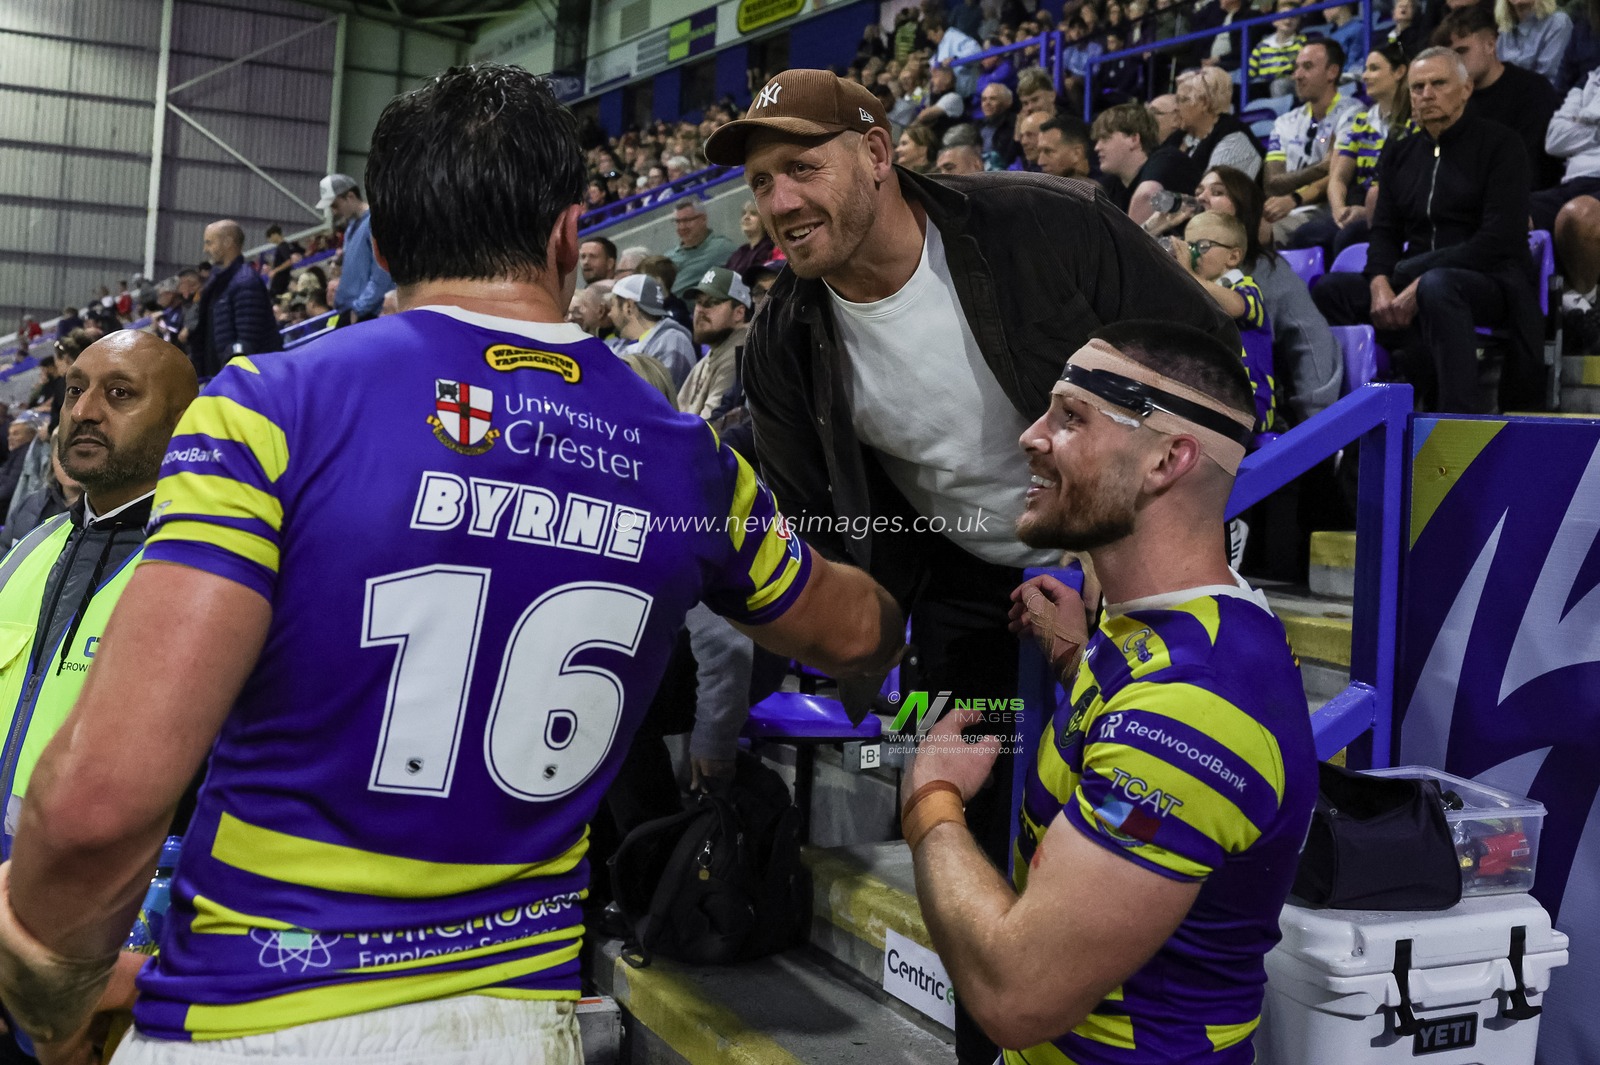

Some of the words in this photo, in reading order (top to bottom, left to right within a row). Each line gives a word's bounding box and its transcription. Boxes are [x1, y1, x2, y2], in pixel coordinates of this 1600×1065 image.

[504, 420, 643, 481] Chester
[624, 427, 640, 444] of
[409, 471, 650, 563] BYRNE
[360, 564, 654, 802] 16
[866, 749, 876, 763] B
[1125, 721, 1247, 793] RedwoodBank
[1111, 768, 1184, 818] TCAT
[1419, 1022, 1473, 1048] YETI
